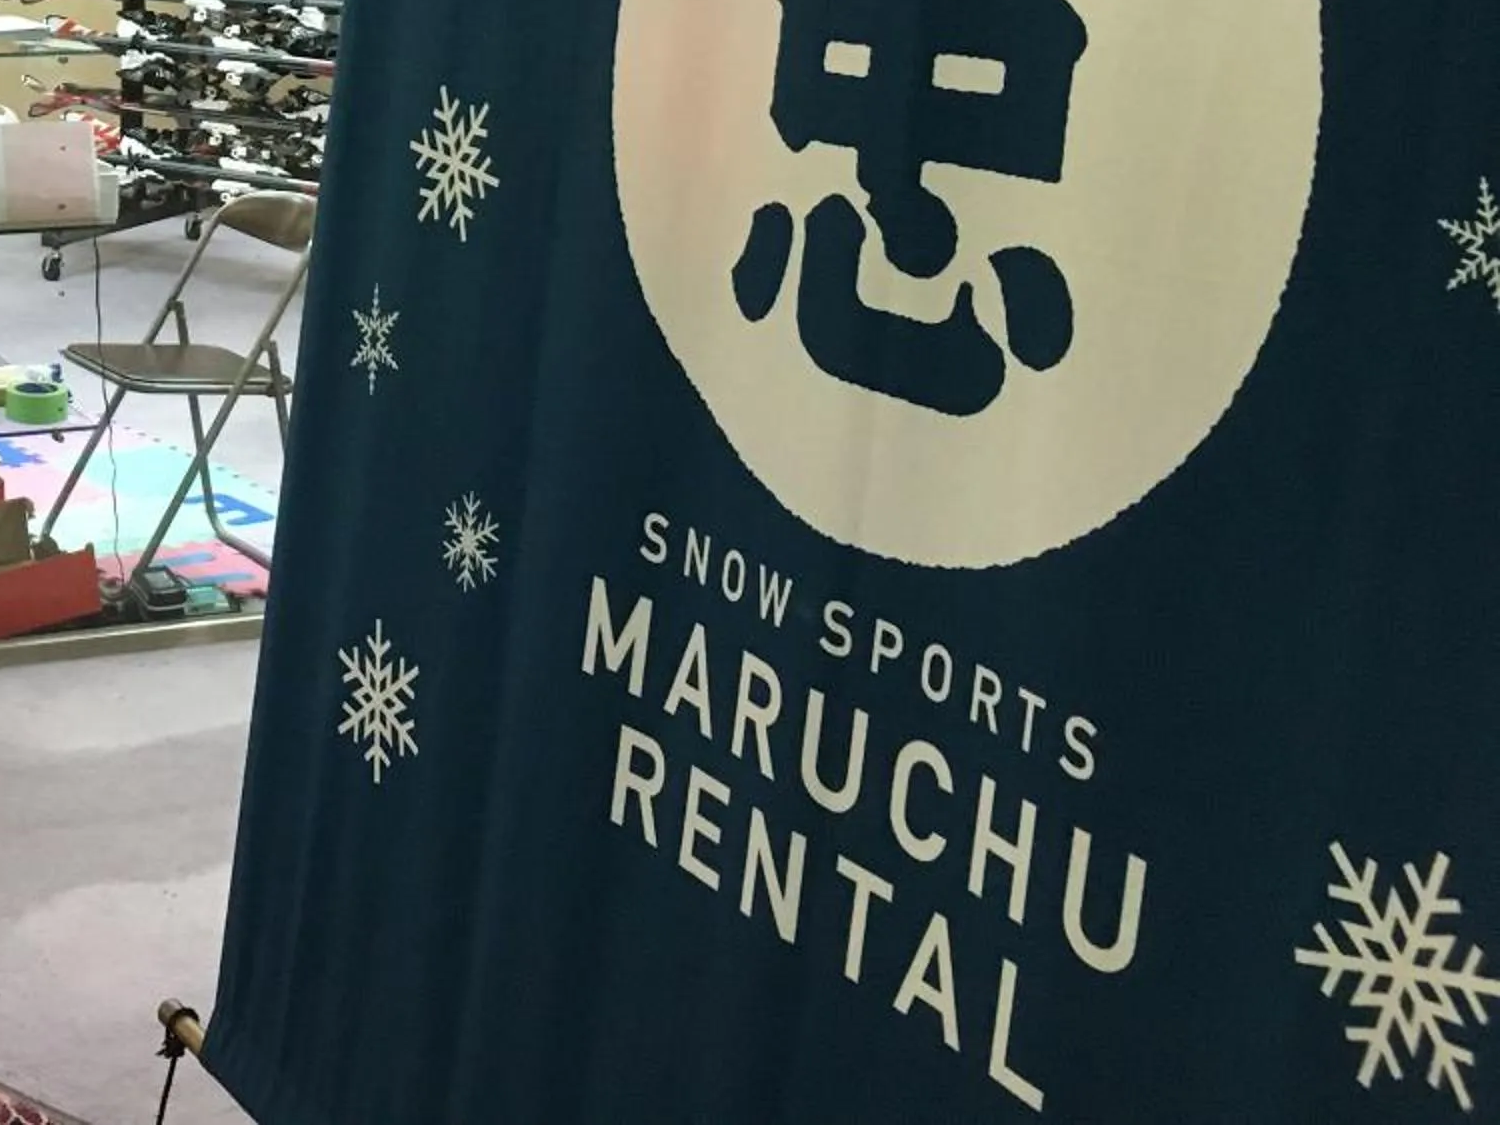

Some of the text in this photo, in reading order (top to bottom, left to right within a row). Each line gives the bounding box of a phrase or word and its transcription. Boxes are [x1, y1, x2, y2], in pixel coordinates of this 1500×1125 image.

[582, 575, 1147, 973] MARUCHU
[640, 512, 1097, 780] SNOW SPORTS
[610, 724, 1045, 1113] RENTAL
